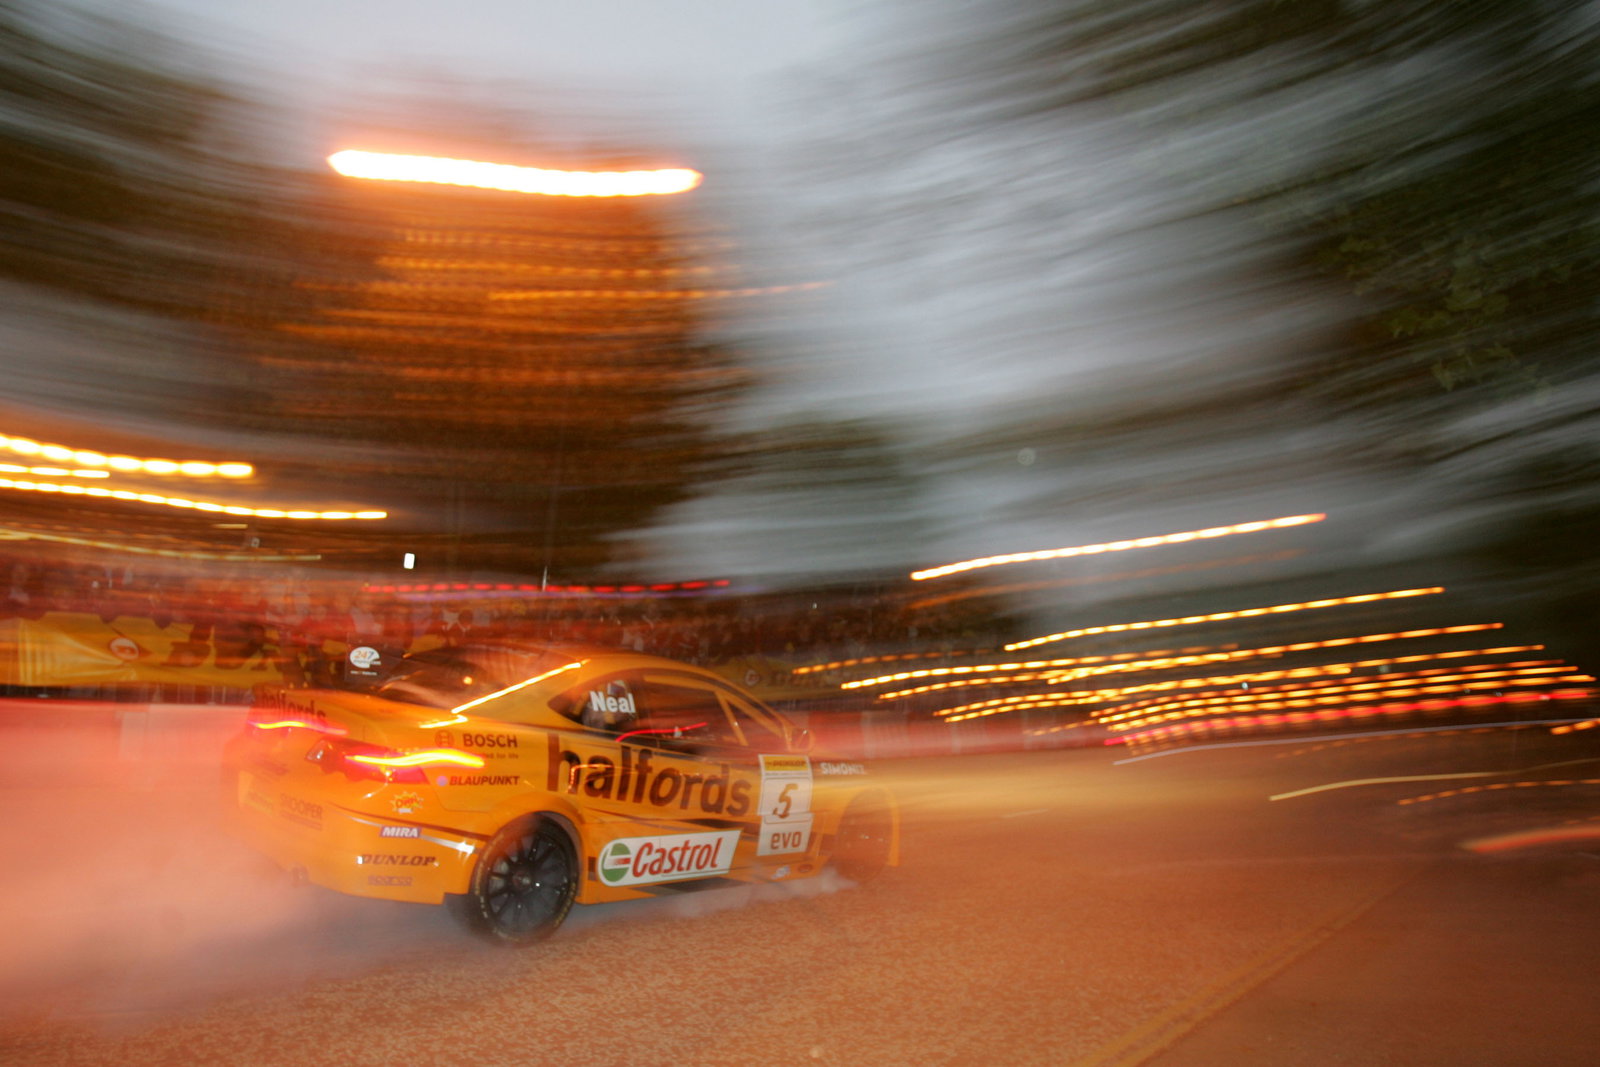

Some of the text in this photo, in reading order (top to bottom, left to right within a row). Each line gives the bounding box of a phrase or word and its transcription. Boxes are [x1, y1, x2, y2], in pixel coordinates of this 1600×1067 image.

[590, 690, 636, 713] Neal
[462, 733, 518, 748] BOSCH
[449, 775, 520, 786] BLAUPUNKT
[547, 733, 752, 817] halfords
[772, 783, 799, 819] 5
[382, 826, 419, 837] MIRA
[770, 831, 802, 850] evo
[361, 854, 437, 866] DUNLOP
[632, 837, 723, 878] Castrol
